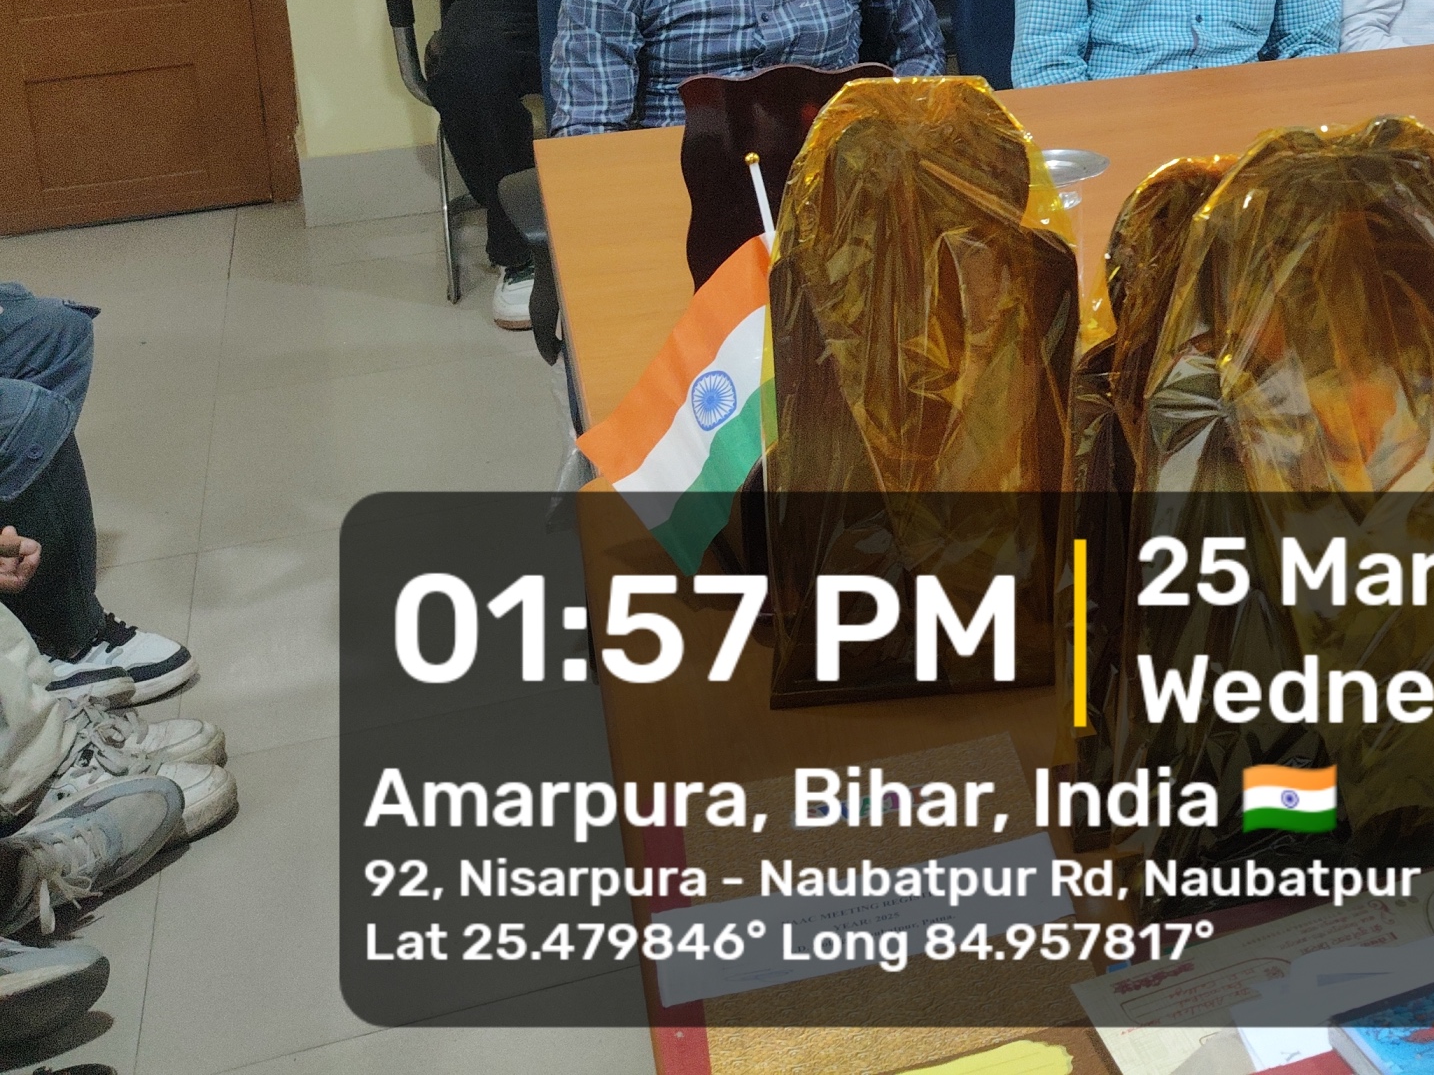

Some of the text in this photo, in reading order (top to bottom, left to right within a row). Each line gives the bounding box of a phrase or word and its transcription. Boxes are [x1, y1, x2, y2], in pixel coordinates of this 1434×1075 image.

[820, 902, 879, 920] MEETING
[883, 891, 938, 907] REGIST
[833, 911, 900, 931] YEAR: 2025
